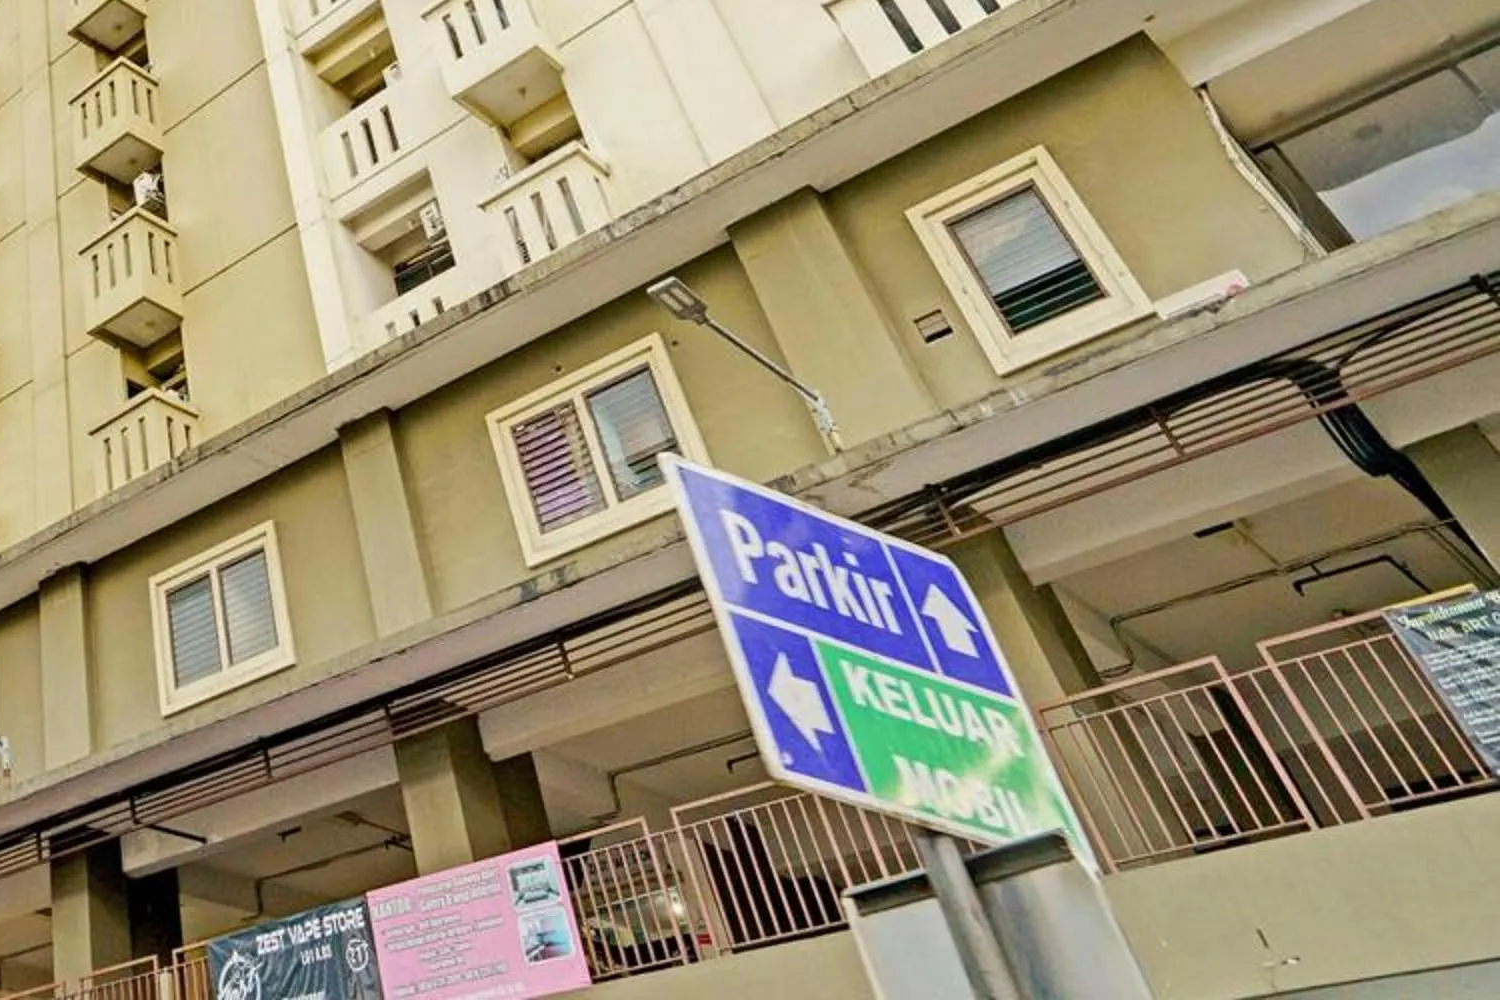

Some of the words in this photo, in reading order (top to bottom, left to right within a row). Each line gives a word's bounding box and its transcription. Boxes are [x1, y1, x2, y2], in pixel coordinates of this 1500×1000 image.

[720, 509, 903, 636] Parkir
[841, 660, 1023, 756] KELUAR
[255, 929, 285, 956] ZEST
[287, 915, 322, 946] VAPE
[322, 907, 366, 937] STORE
